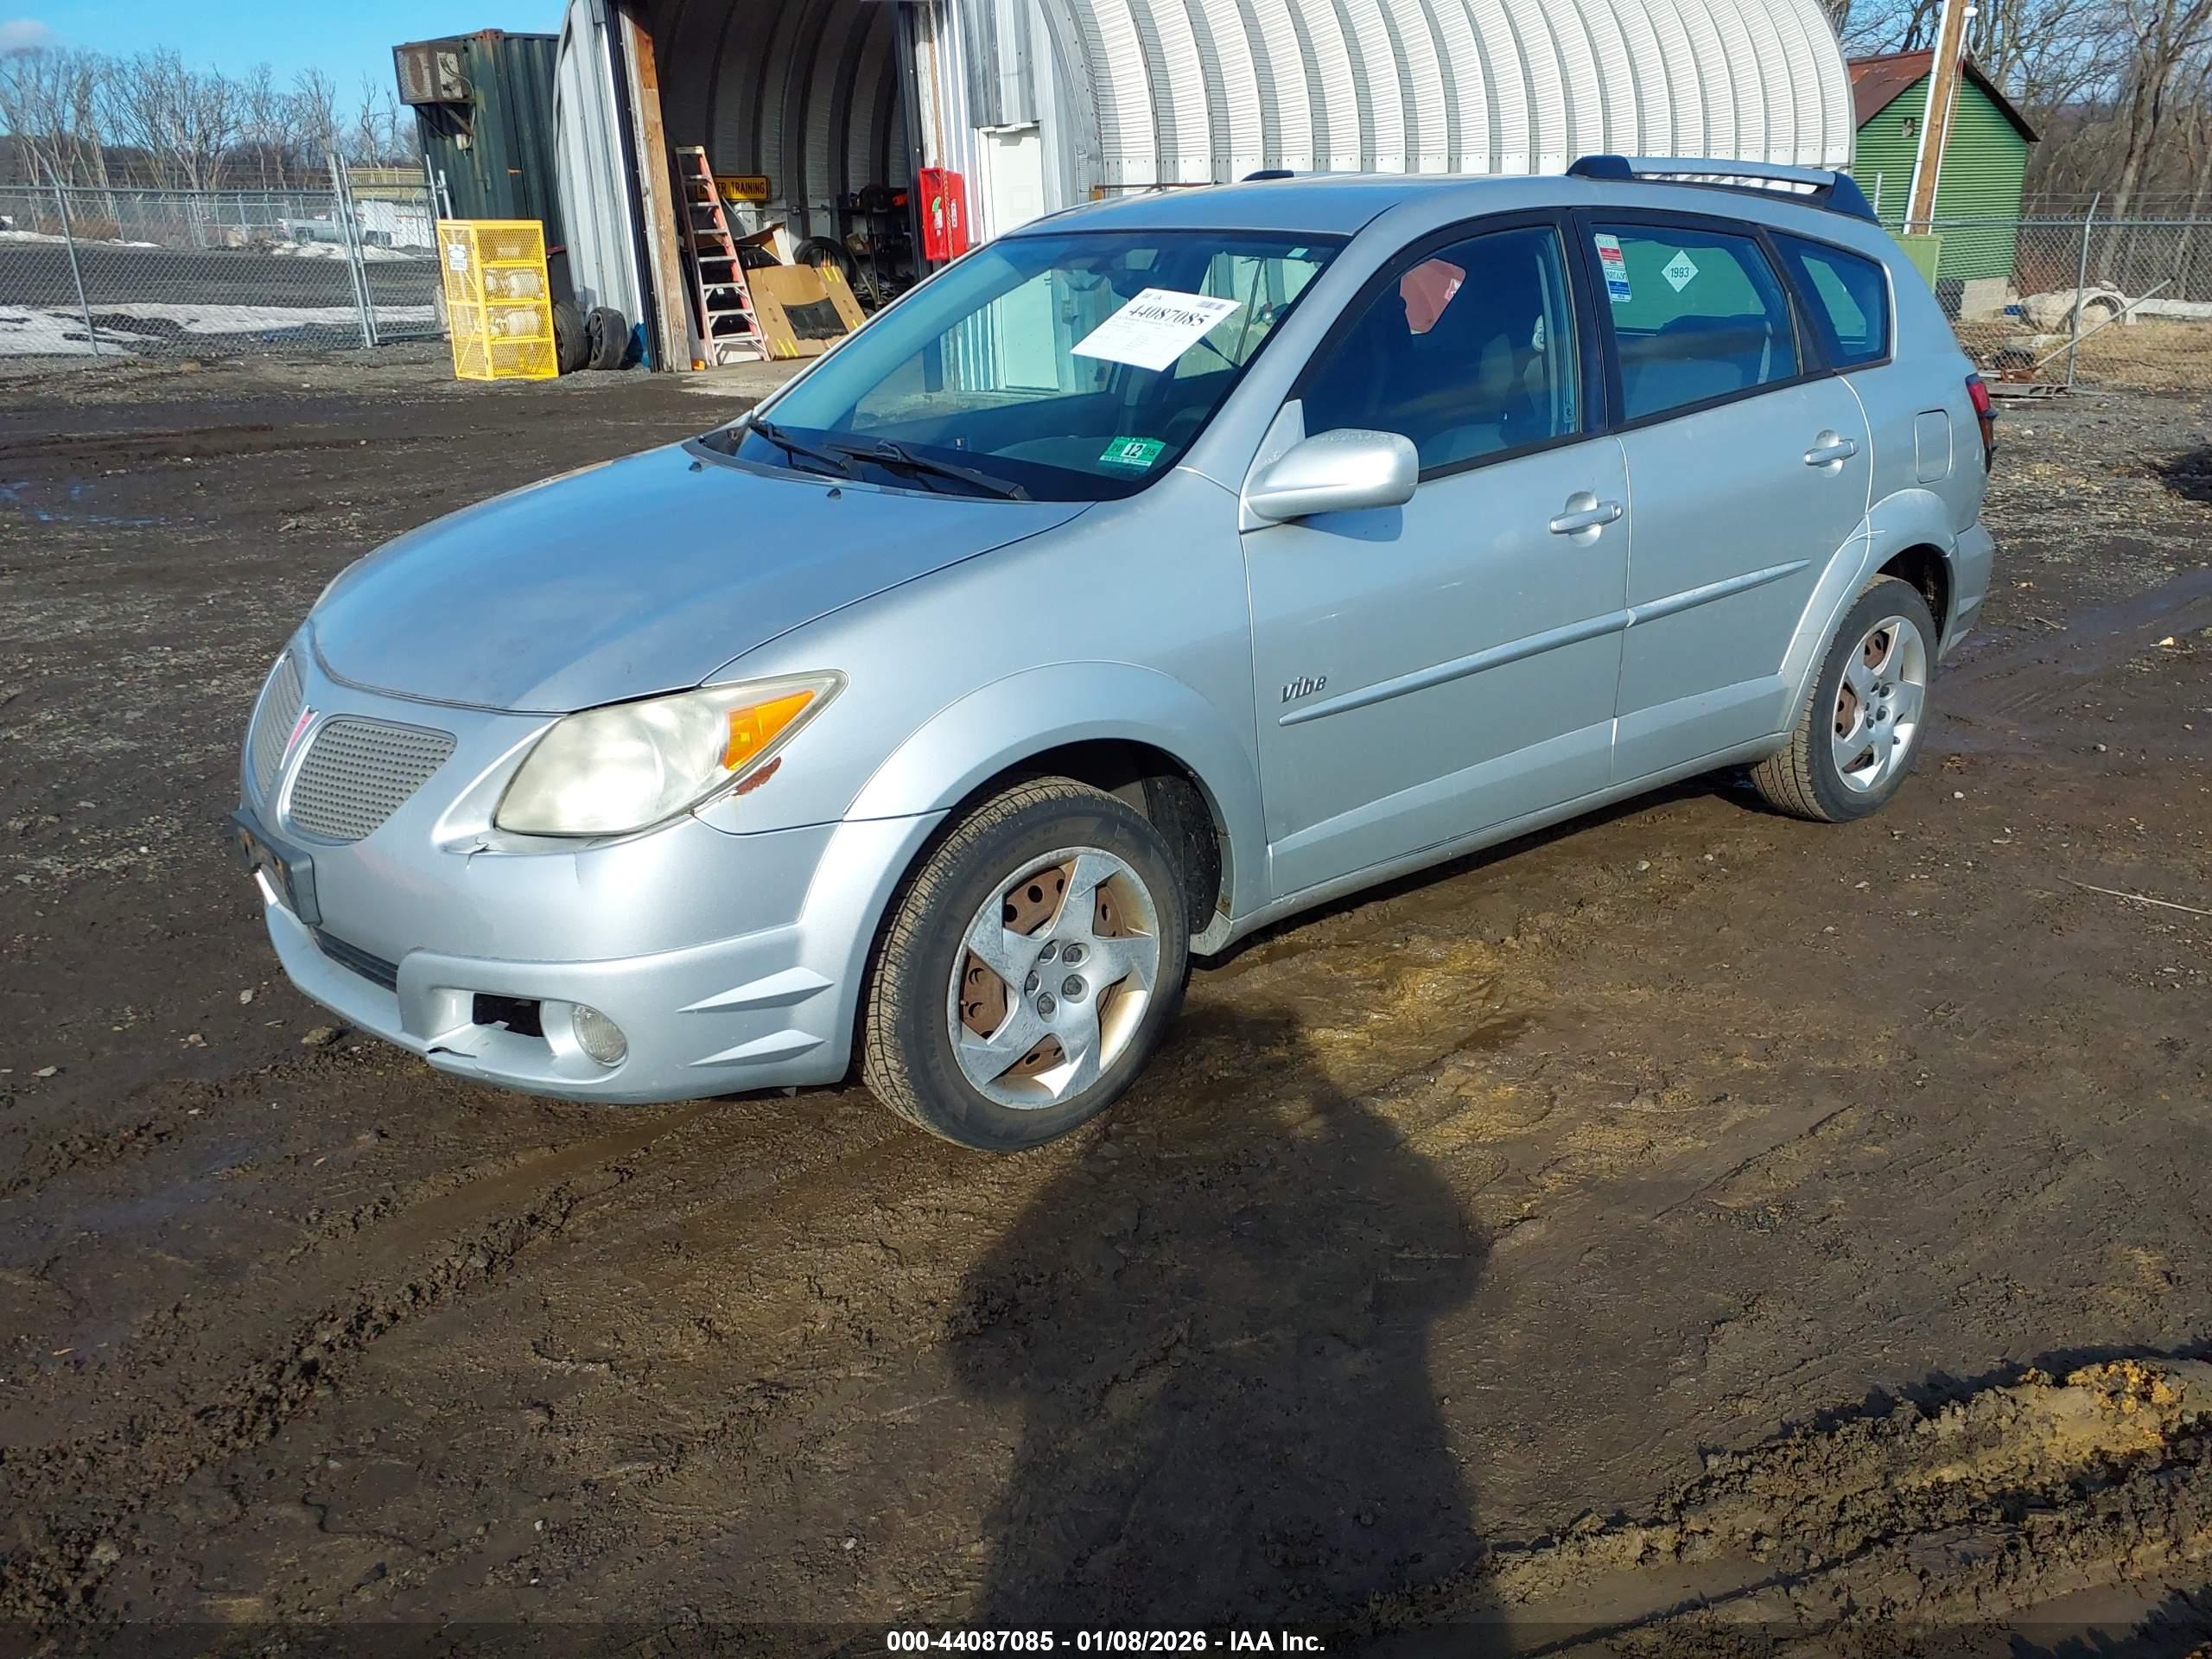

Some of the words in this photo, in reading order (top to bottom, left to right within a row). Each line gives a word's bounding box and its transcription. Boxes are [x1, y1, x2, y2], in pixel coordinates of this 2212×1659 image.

[730, 181, 766, 194] TRAINING
[1669, 266, 1690, 278] 1993
[1128, 303, 1211, 327] 44087085
[1123, 442, 1144, 457] 12
[1280, 676, 1327, 703] vibe
